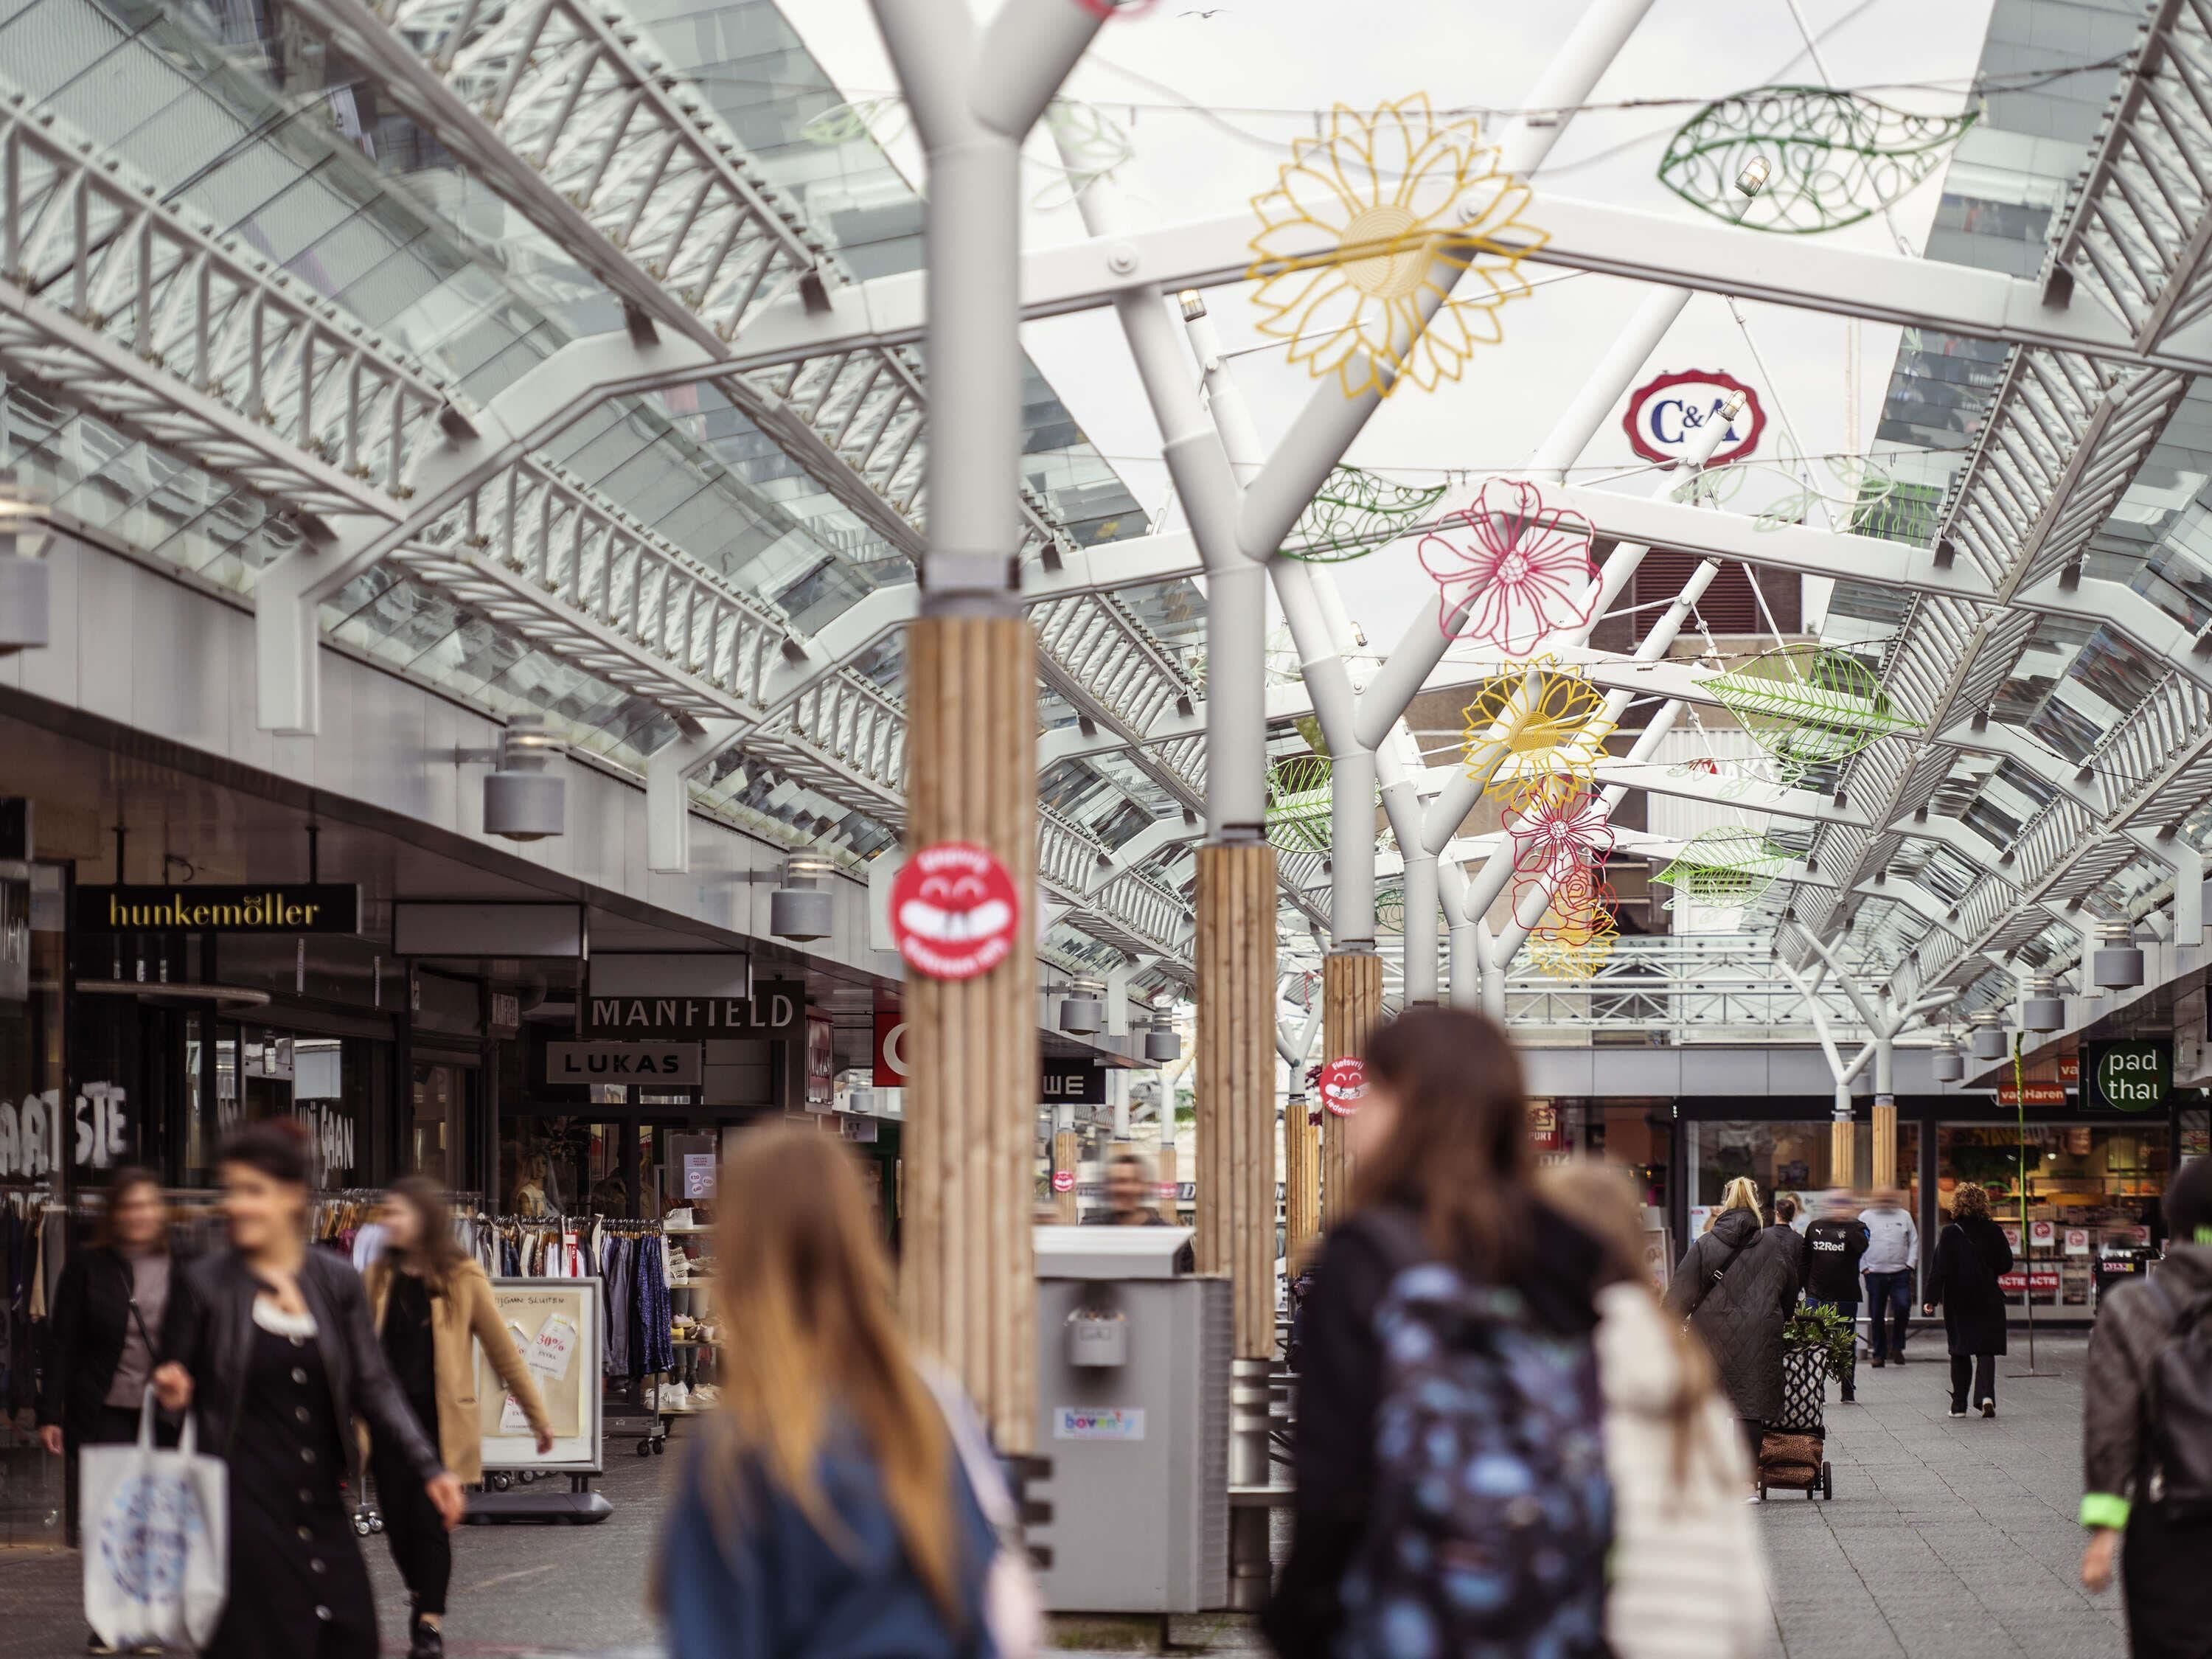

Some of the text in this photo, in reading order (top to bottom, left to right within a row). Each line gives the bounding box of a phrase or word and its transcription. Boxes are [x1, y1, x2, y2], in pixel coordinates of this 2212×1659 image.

[110, 892, 320, 926] hunkemöller
[591, 995, 793, 1027] MANFIELD
[565, 1054, 679, 1074] LUKAS
[1332, 1059, 1364, 1071] Fietsvrij
[2110, 1050, 2157, 1075] pad
[2001, 1090, 2064, 1099] vaHaren
[2108, 1079, 2158, 1100] thai
[1813, 1242, 1845, 1251] 32Red
[2029, 1275, 2058, 1286] ACTIE
[537, 1333, 566, 1352] 30%
